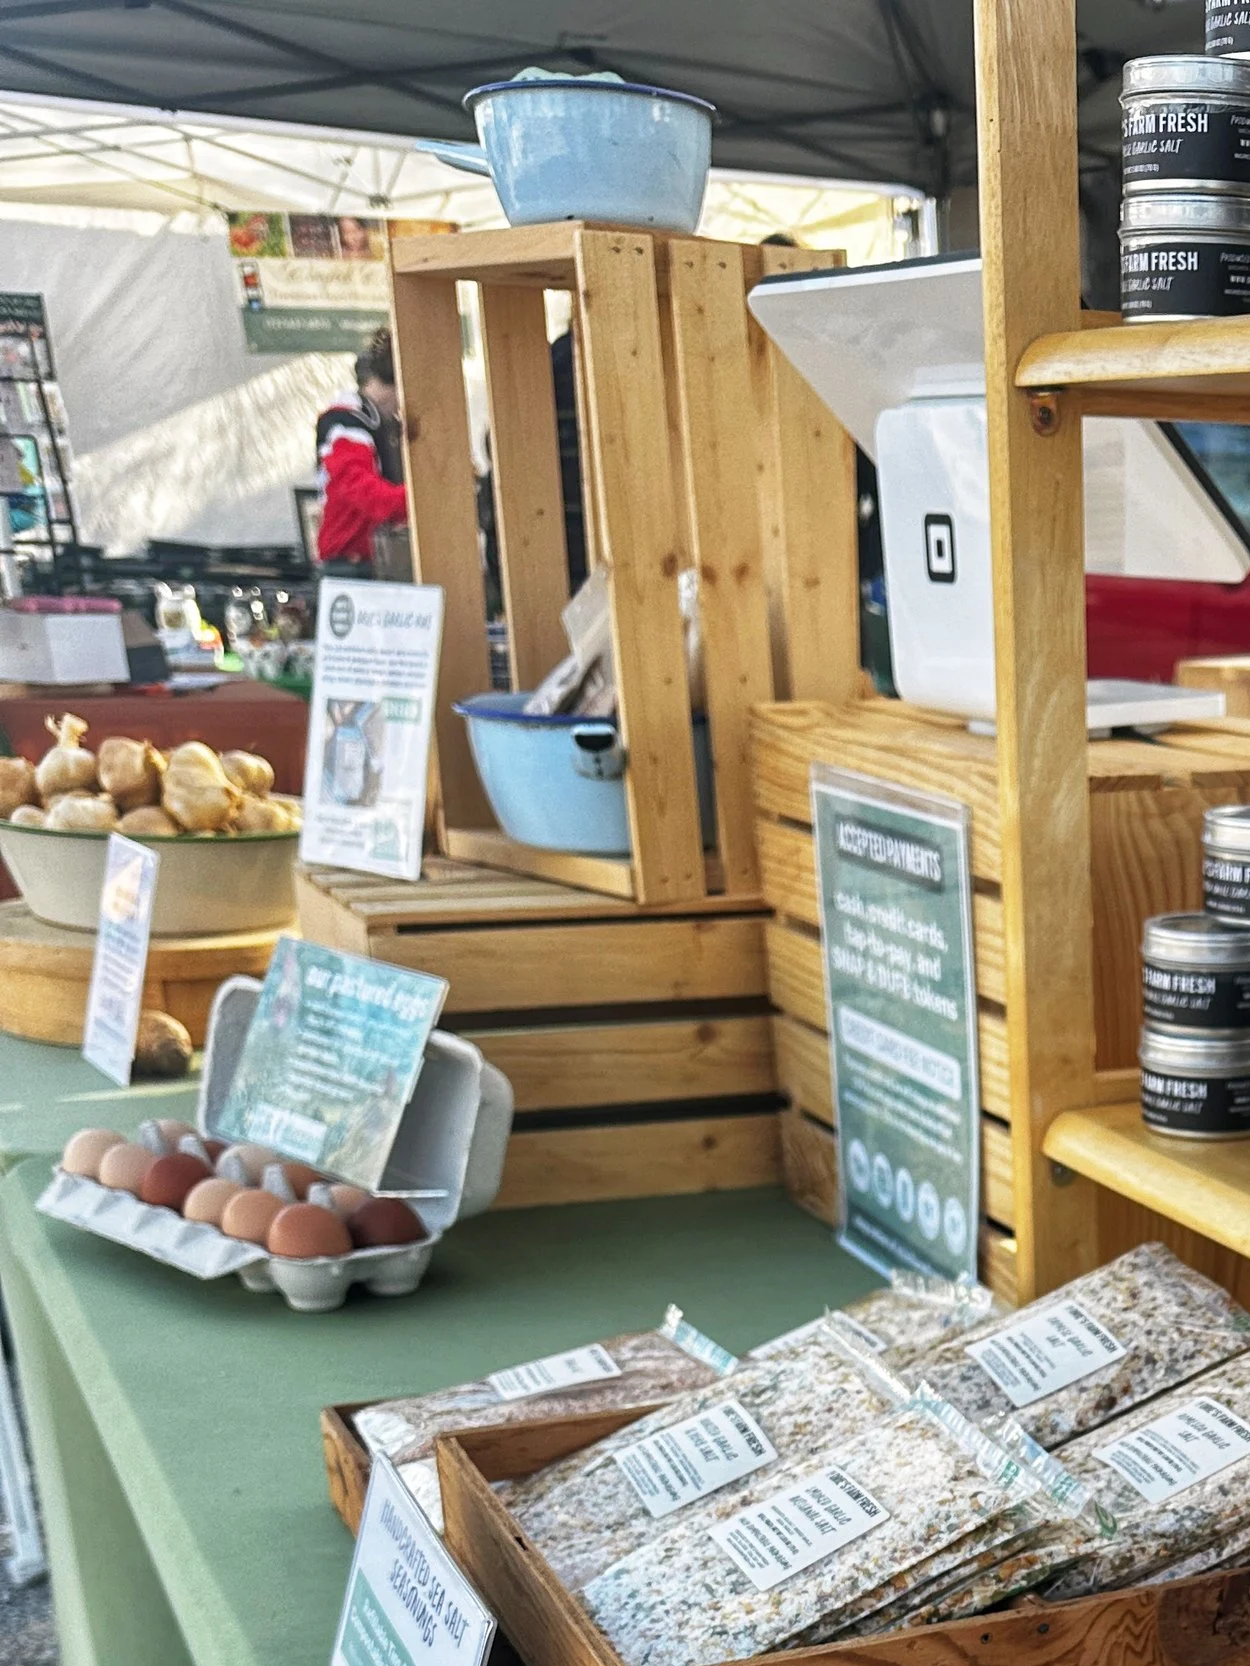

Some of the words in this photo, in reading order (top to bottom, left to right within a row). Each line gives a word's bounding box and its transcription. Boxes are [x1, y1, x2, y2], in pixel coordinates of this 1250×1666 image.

[1159, 113, 1208, 133] FRESH
[1160, 138, 1183, 154] SALT
[1152, 251, 1198, 272] FRESH
[1172, 975, 1216, 995] FRESH
[1166, 1079, 1207, 1099] FRESH
[380, 1498, 430, 1587] HANDCRAFTED
[428, 1576, 446, 1616] SEA
[445, 1601, 469, 1648] SALT
[390, 1558, 437, 1648] SEASONINGS
